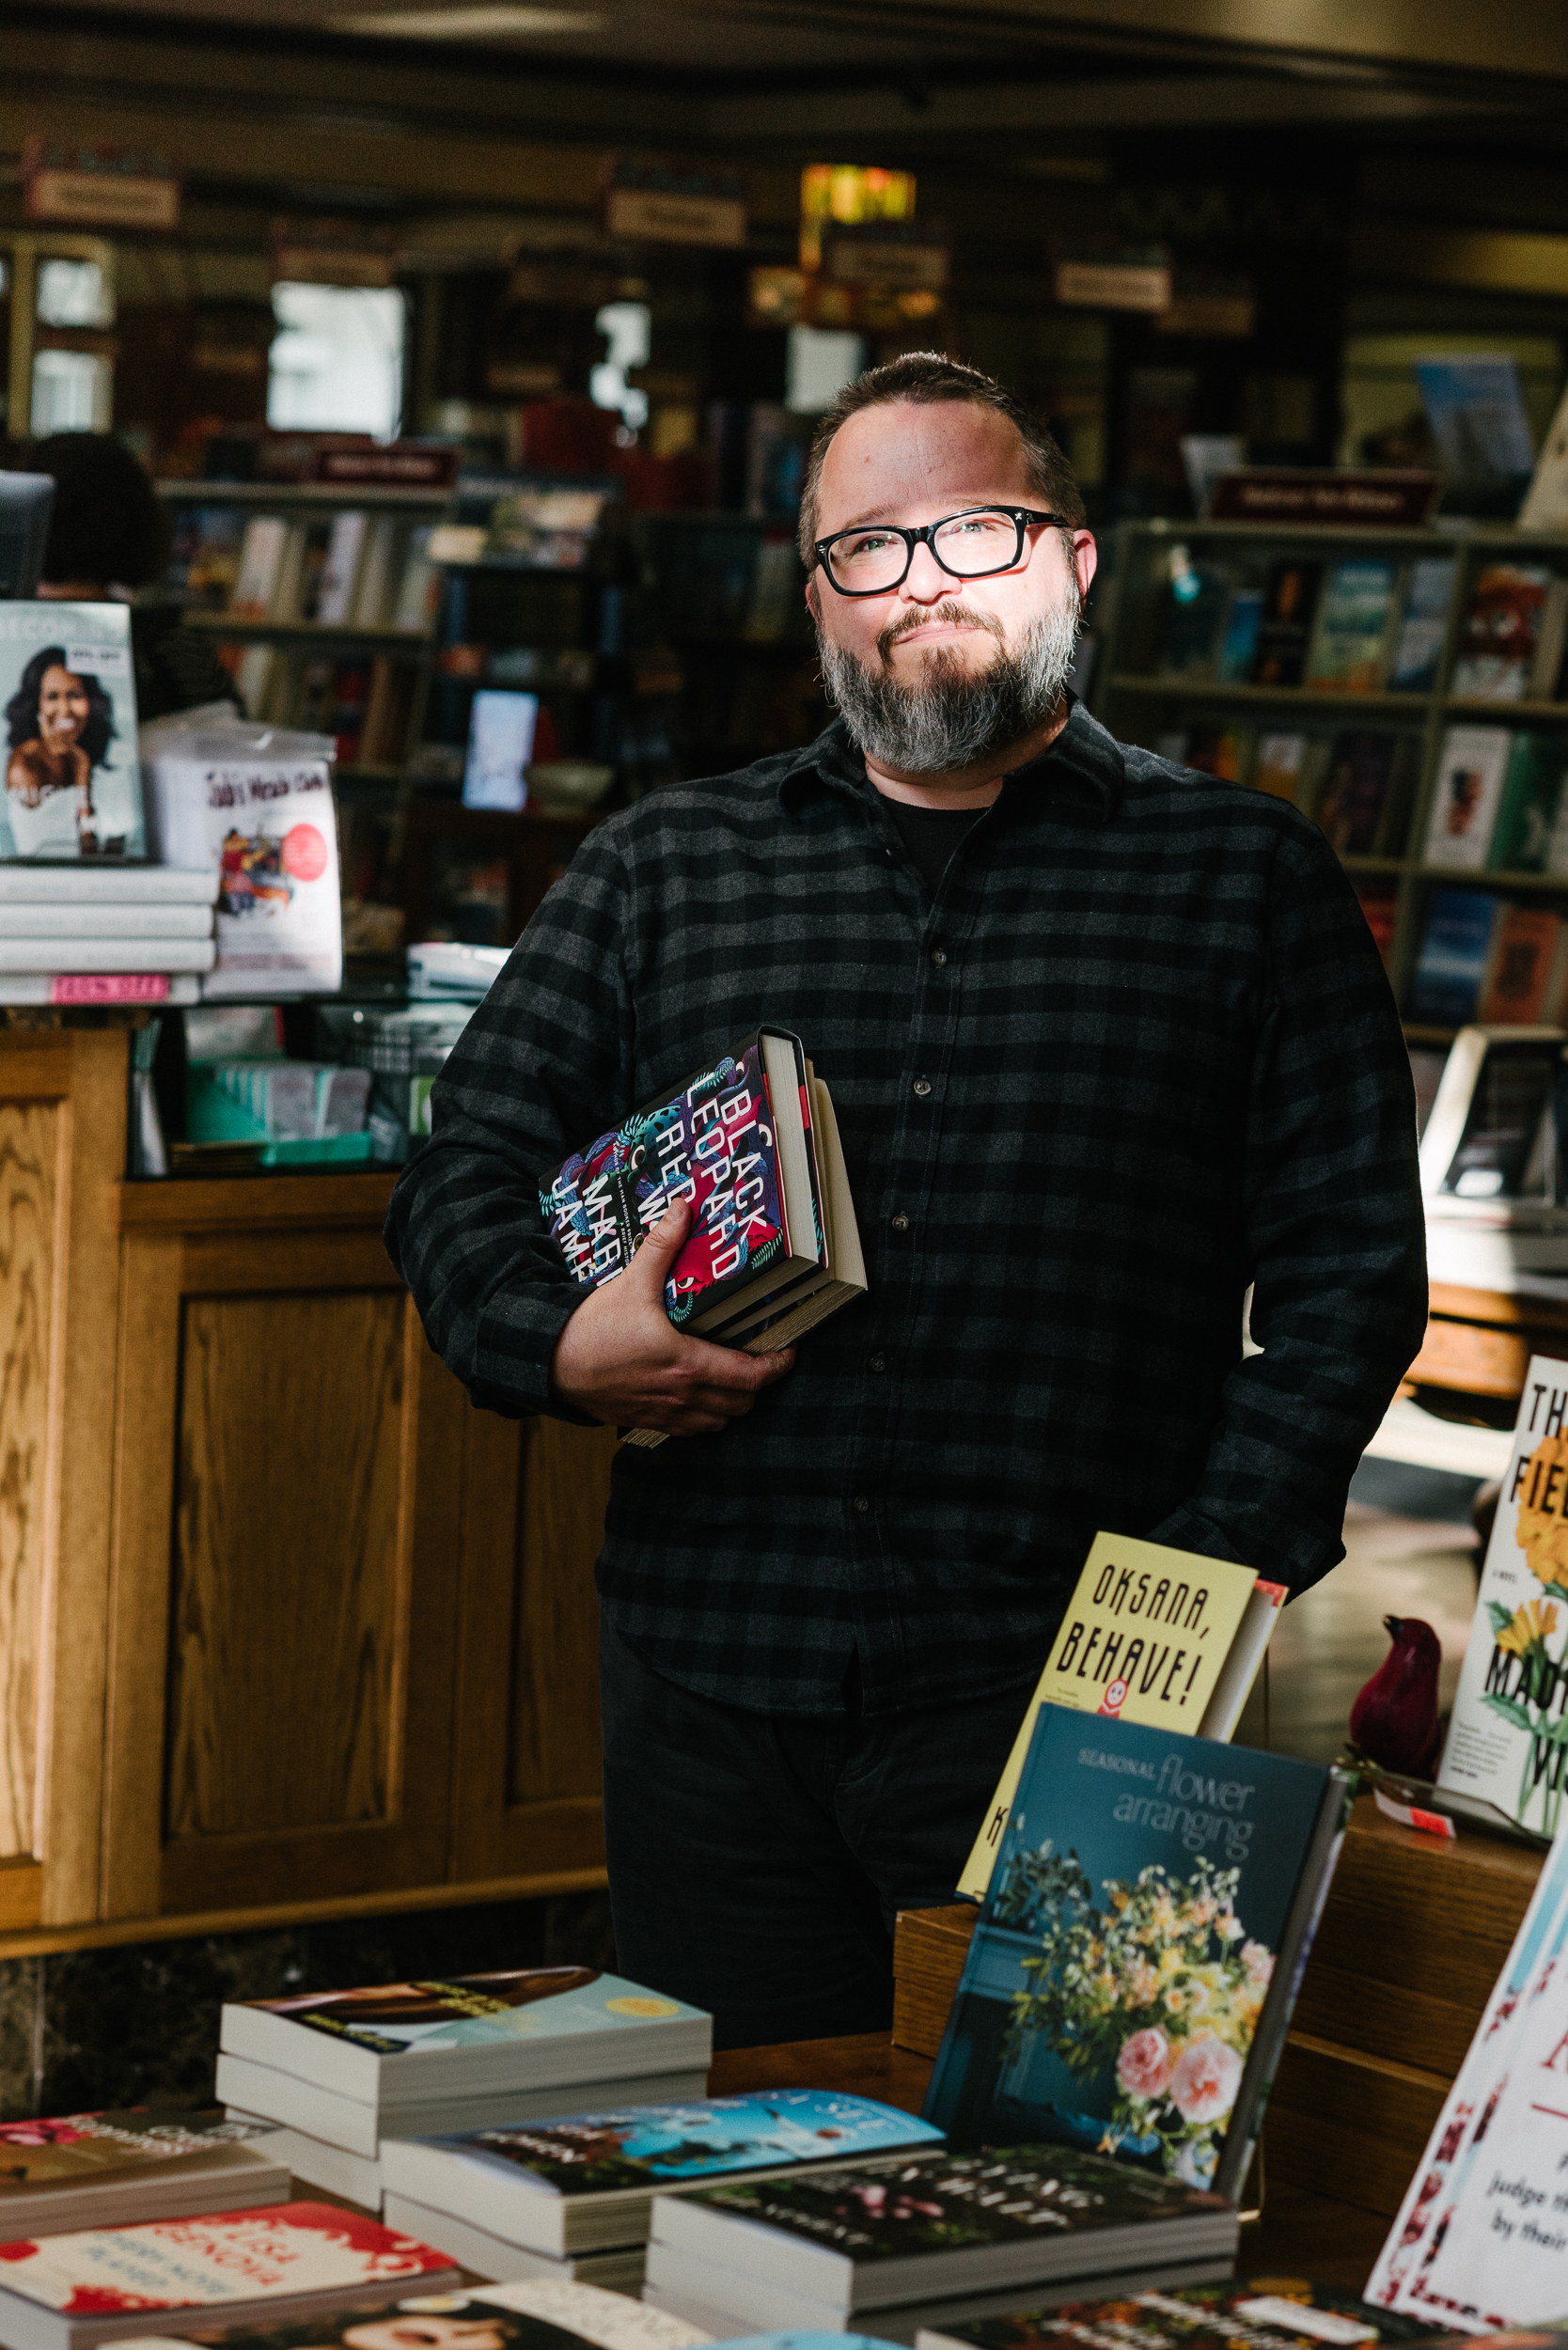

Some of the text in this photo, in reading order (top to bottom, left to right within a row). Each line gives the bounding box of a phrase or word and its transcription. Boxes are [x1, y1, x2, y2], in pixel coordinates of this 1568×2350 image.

[687, 1073, 740, 1279] LEOPARD
[721, 1089, 767, 1245] BLACK
[1529, 1384, 1568, 1439] TH
[1091, 1564, 1210, 1639] OKSANA,
[1056, 1622, 1202, 1706] BEHAVE!
[1077, 1747, 1257, 1813] SEASONAL flower
[1111, 1792, 1256, 1862] arranging
[1486, 2170, 1548, 2208] judge
[1491, 2208, 1515, 2242] by
